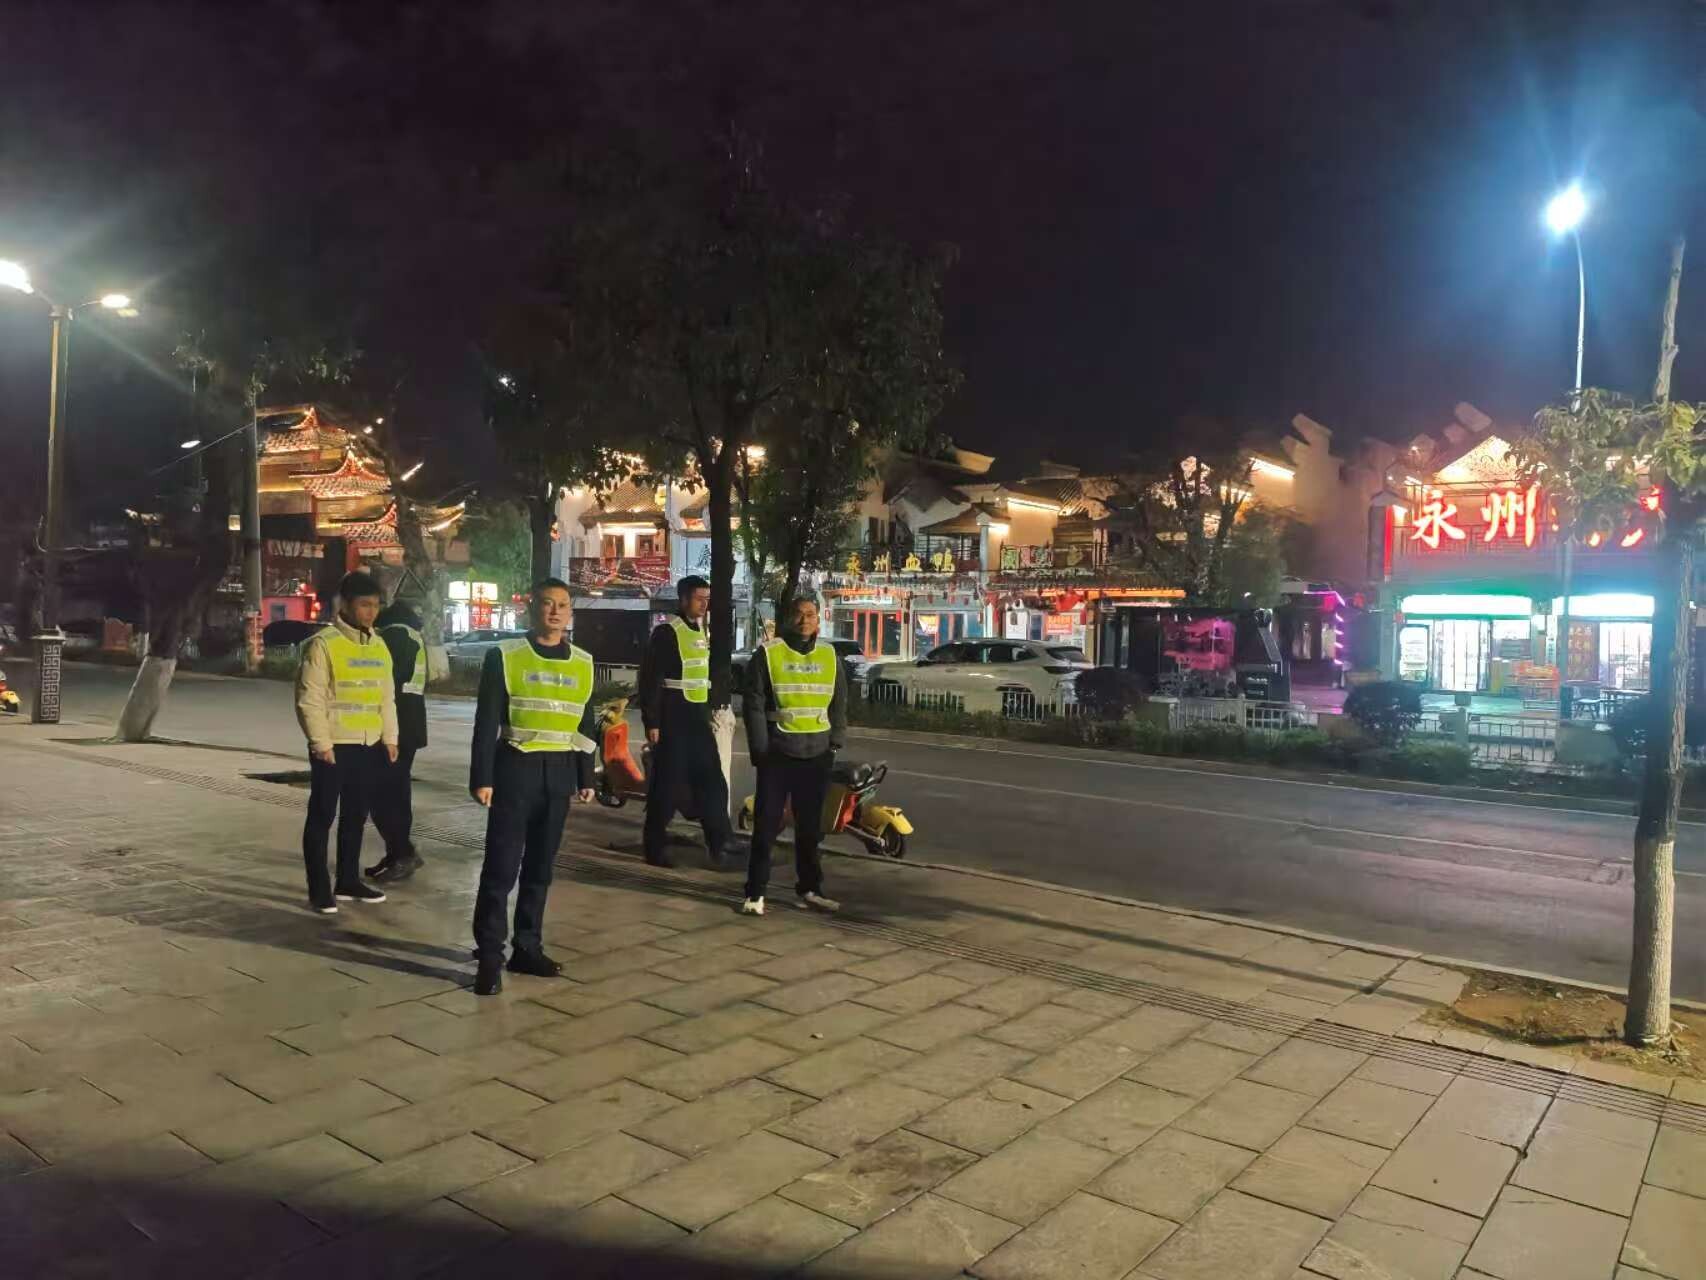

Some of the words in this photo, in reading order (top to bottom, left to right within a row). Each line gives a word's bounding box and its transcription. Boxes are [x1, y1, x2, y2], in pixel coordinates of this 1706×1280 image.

[1411, 484, 1662, 548] 永州
[846, 550, 955, 576] 永州血鸭
